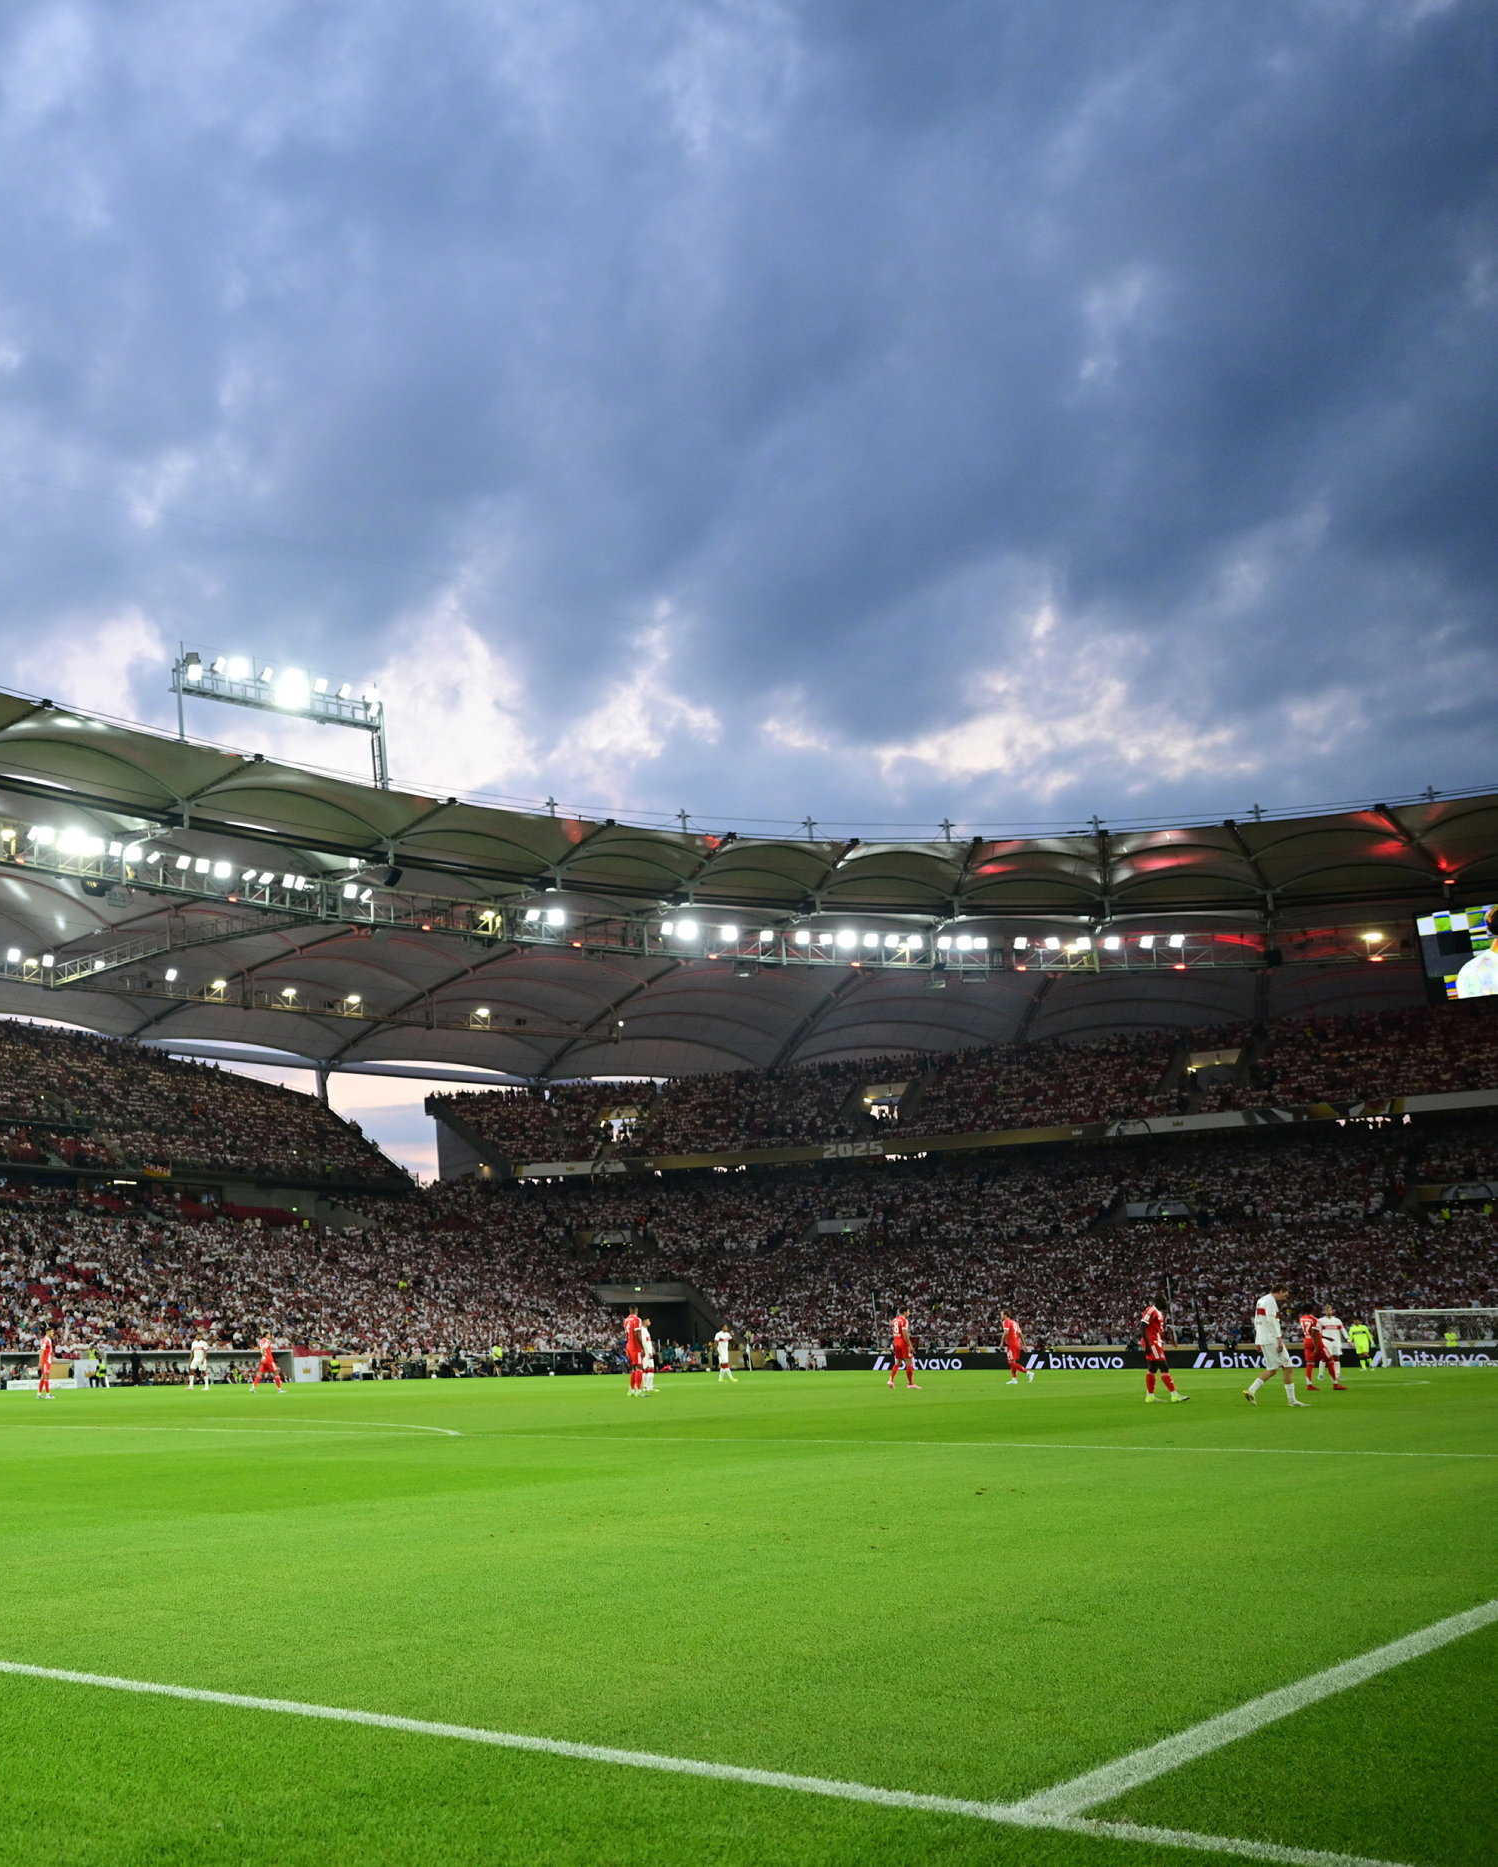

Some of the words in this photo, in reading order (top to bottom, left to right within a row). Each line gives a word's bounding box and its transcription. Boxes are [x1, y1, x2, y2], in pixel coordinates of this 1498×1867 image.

[823, 1142, 884, 1159] 2025
[893, 1321, 900, 1333] 8
[1299, 1322, 1313, 1336] 17
[1048, 1353, 1124, 1369] bitvavo
[1219, 1352, 1303, 1368] bitvo
